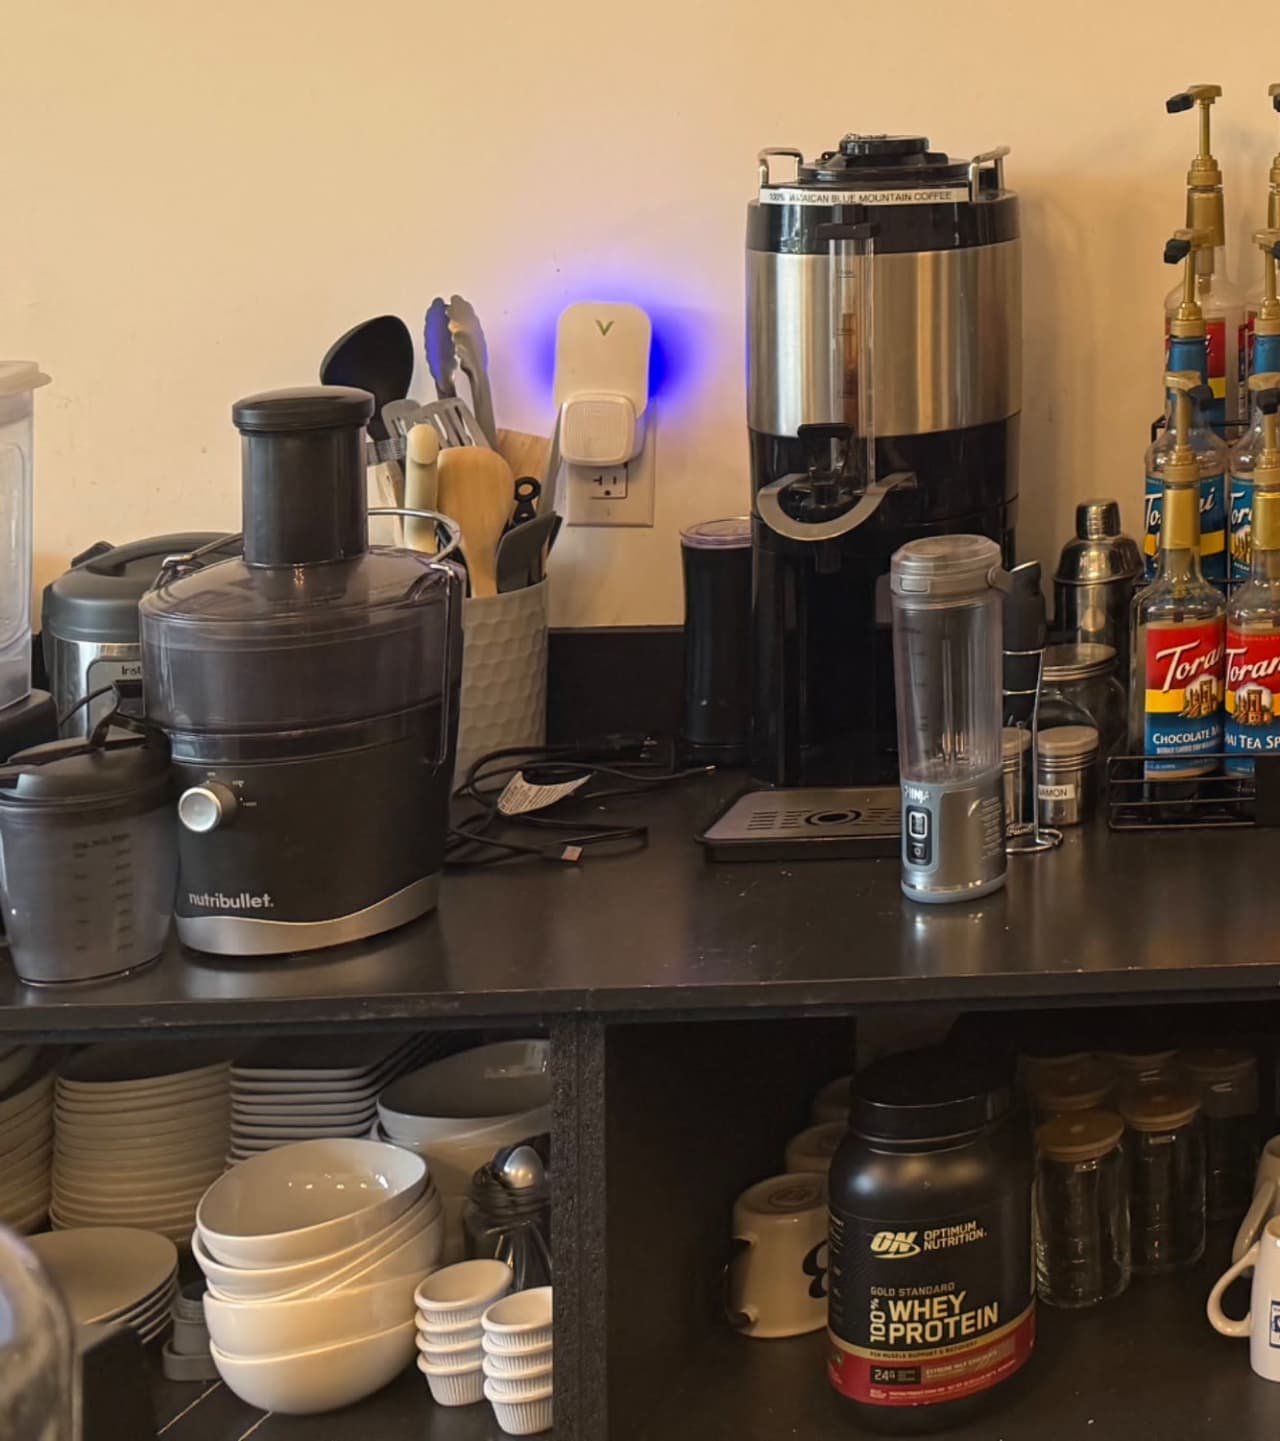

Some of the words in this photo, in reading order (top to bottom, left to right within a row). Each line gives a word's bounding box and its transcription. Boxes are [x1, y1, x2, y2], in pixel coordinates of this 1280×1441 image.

[830, 193, 856, 204] BLUE
[860, 192, 912, 203] MOUNTAIN
[914, 191, 952, 201] COFFEE
[1152, 729, 1211, 745] CHOCOLATE
[1240, 734, 1263, 749] TEA
[923, 1220, 977, 1240] OPTIMUM
[870, 1285, 897, 1296] GOLD
[898, 1281, 956, 1295] STANDARD
[888, 1291, 967, 1322] WHEY
[888, 1301, 1000, 1345] PROTEIN
